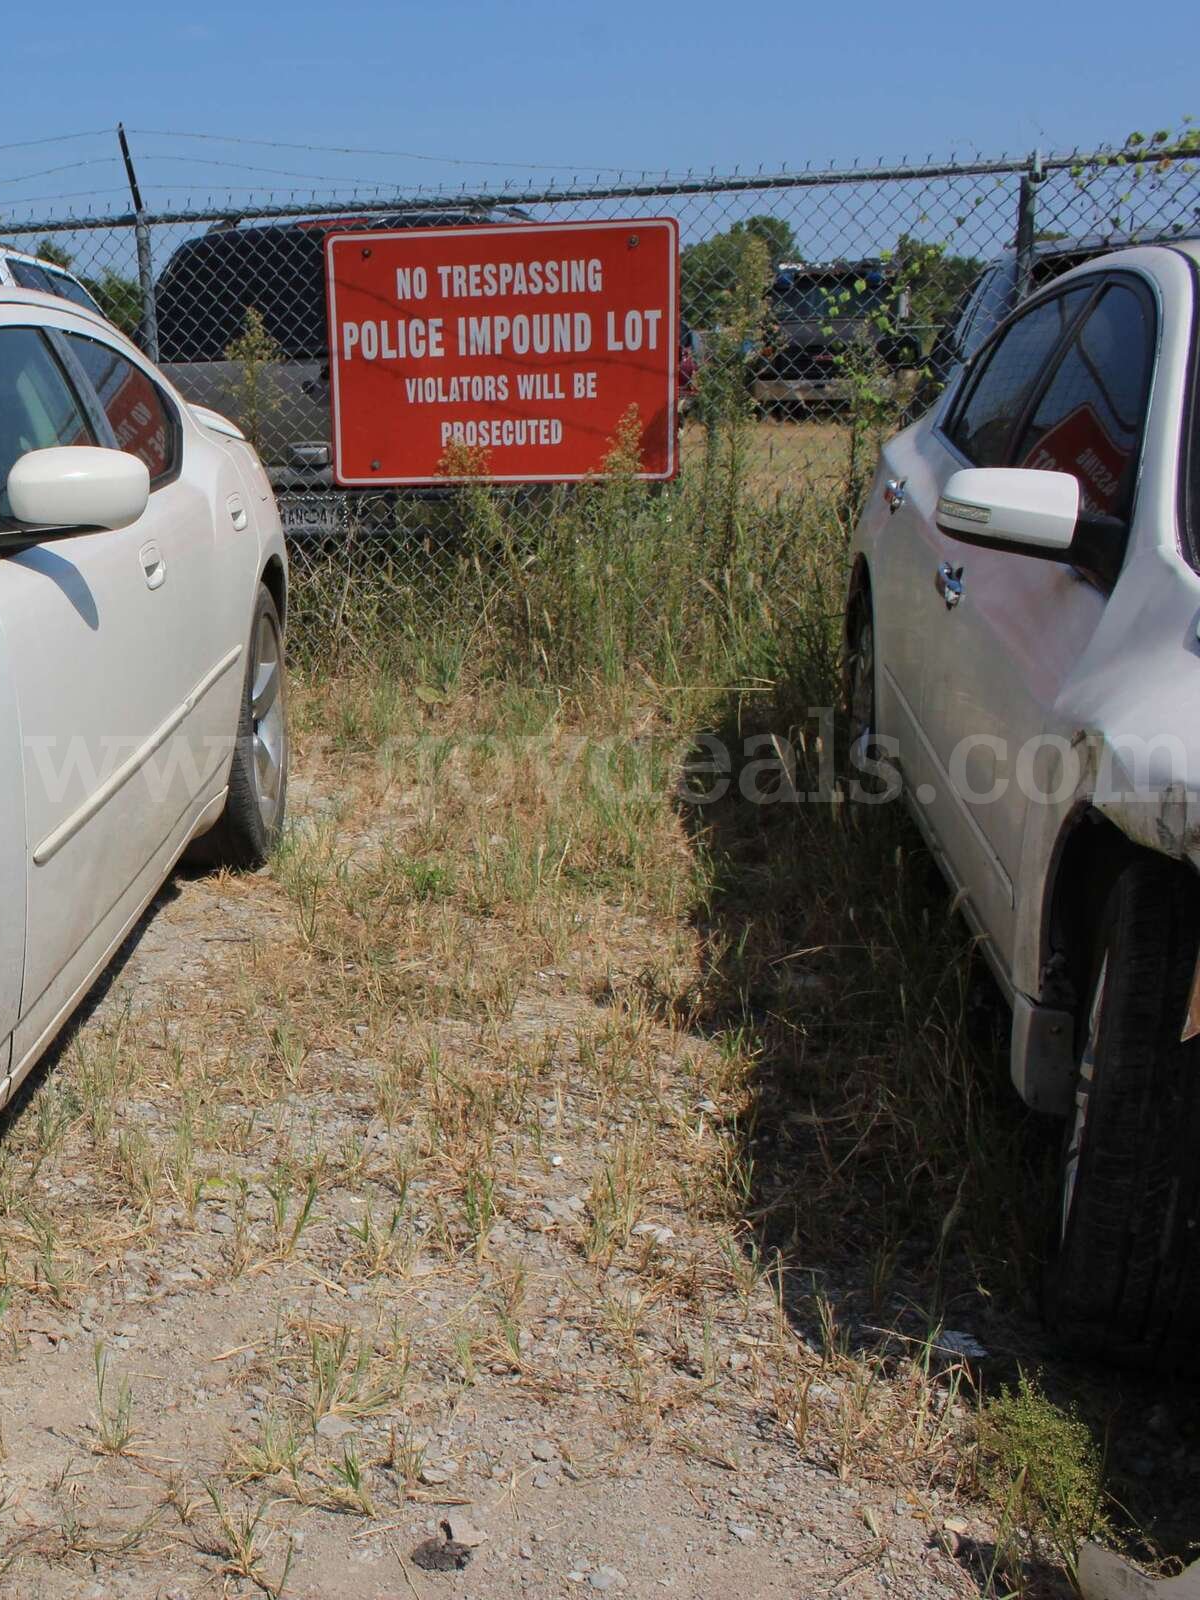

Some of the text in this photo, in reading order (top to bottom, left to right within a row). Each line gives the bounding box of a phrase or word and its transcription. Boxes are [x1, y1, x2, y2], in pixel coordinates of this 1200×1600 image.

[396, 258, 603, 300] NO TRESPASSING
[343, 309, 662, 361] POLICE IMPOUND LOT
[405, 372, 598, 404] VIOLATORS WILL BE
[440, 418, 563, 448] PROSECUTED
